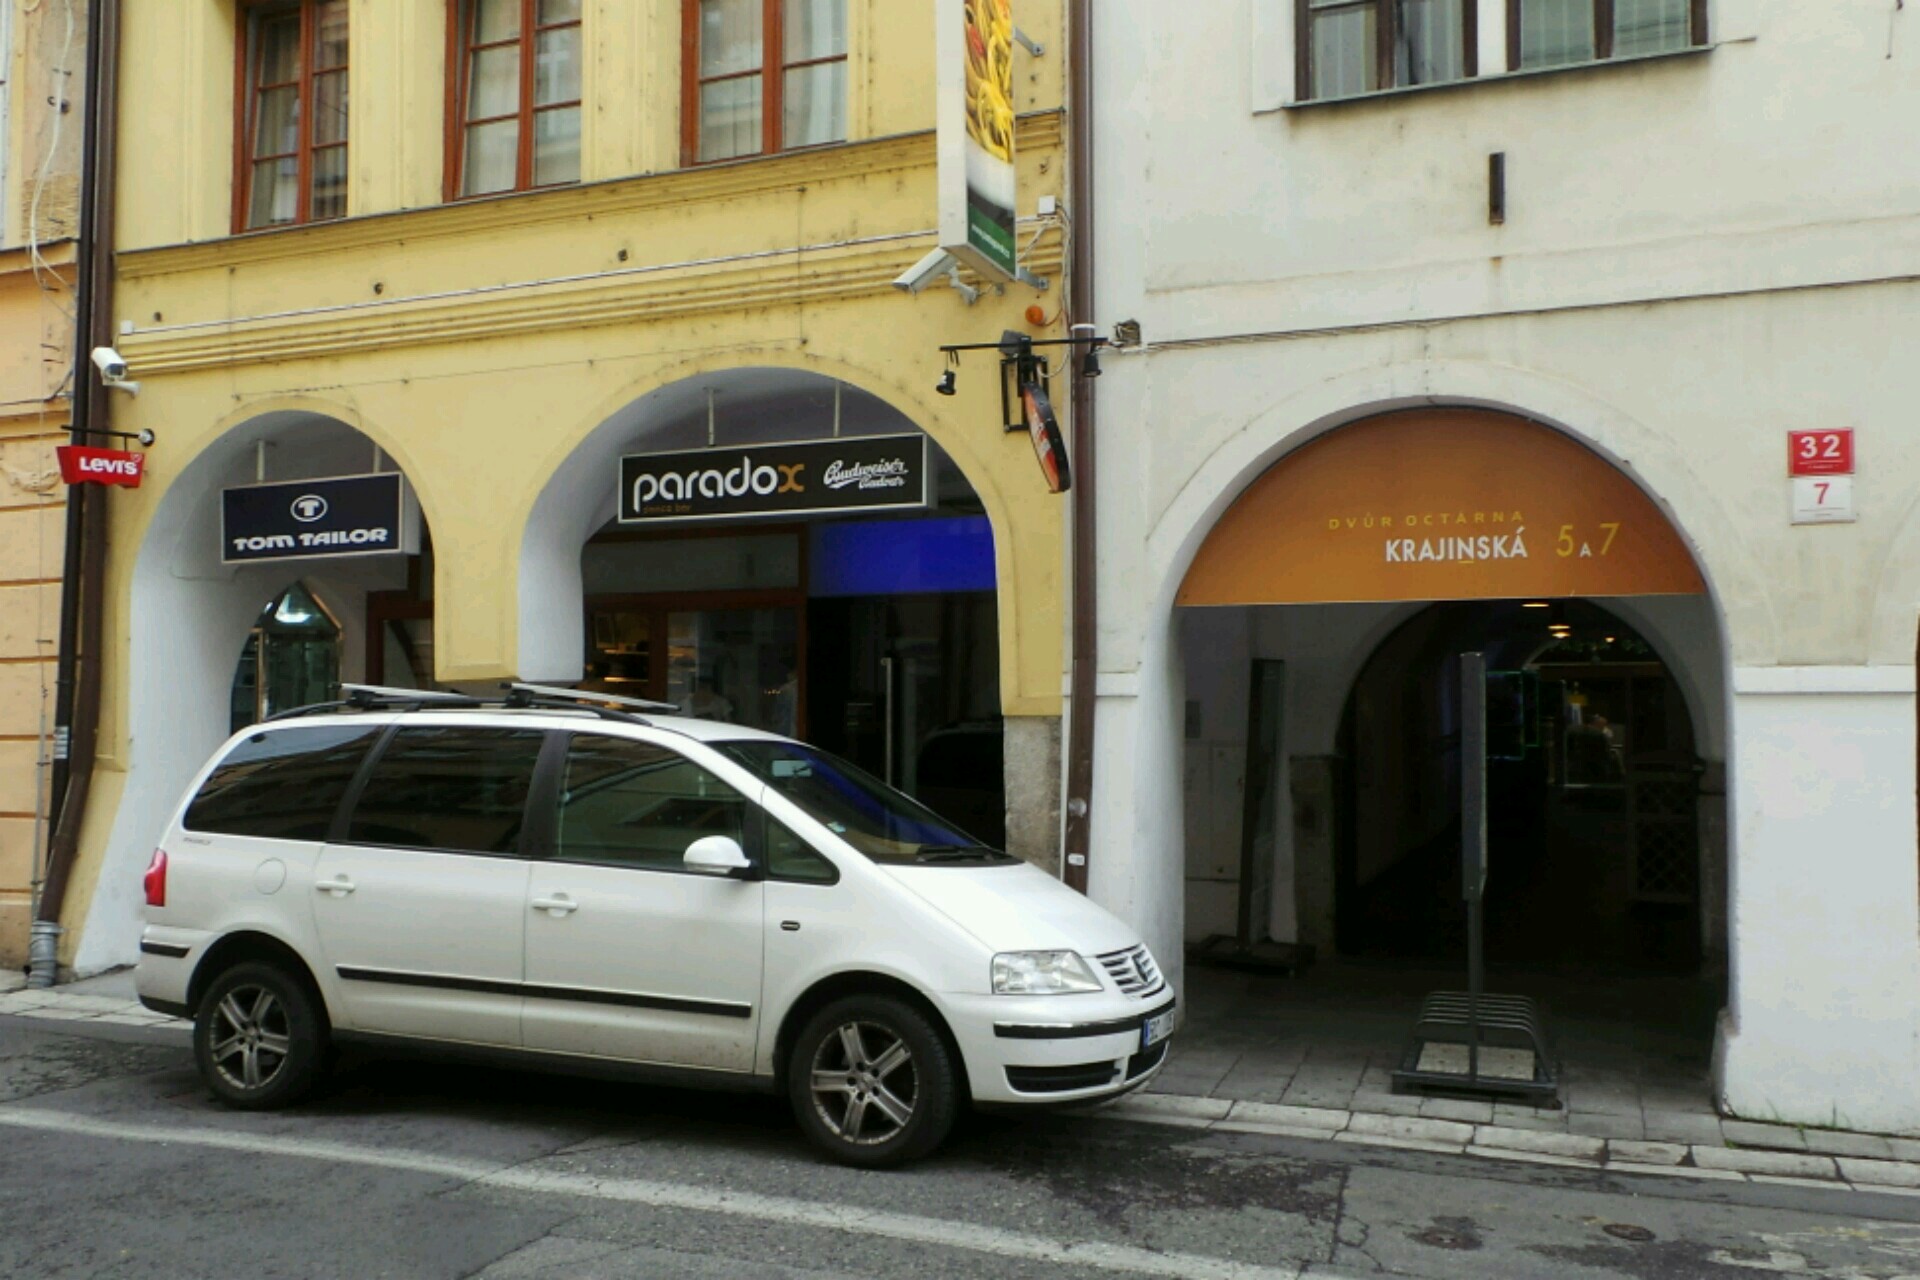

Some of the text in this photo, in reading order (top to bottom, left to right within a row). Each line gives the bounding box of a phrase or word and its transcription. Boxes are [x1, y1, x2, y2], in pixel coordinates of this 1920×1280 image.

[1800, 434, 1840, 459] 32
[633, 456, 805, 513] paradox
[1814, 482, 1830, 505] 7
[233, 527, 388, 552] TOM TAILOR
[1385, 526, 1528, 563] KRAJINSKÁ
[1556, 524, 1574, 557] 5
[1599, 522, 1620, 556] 7
